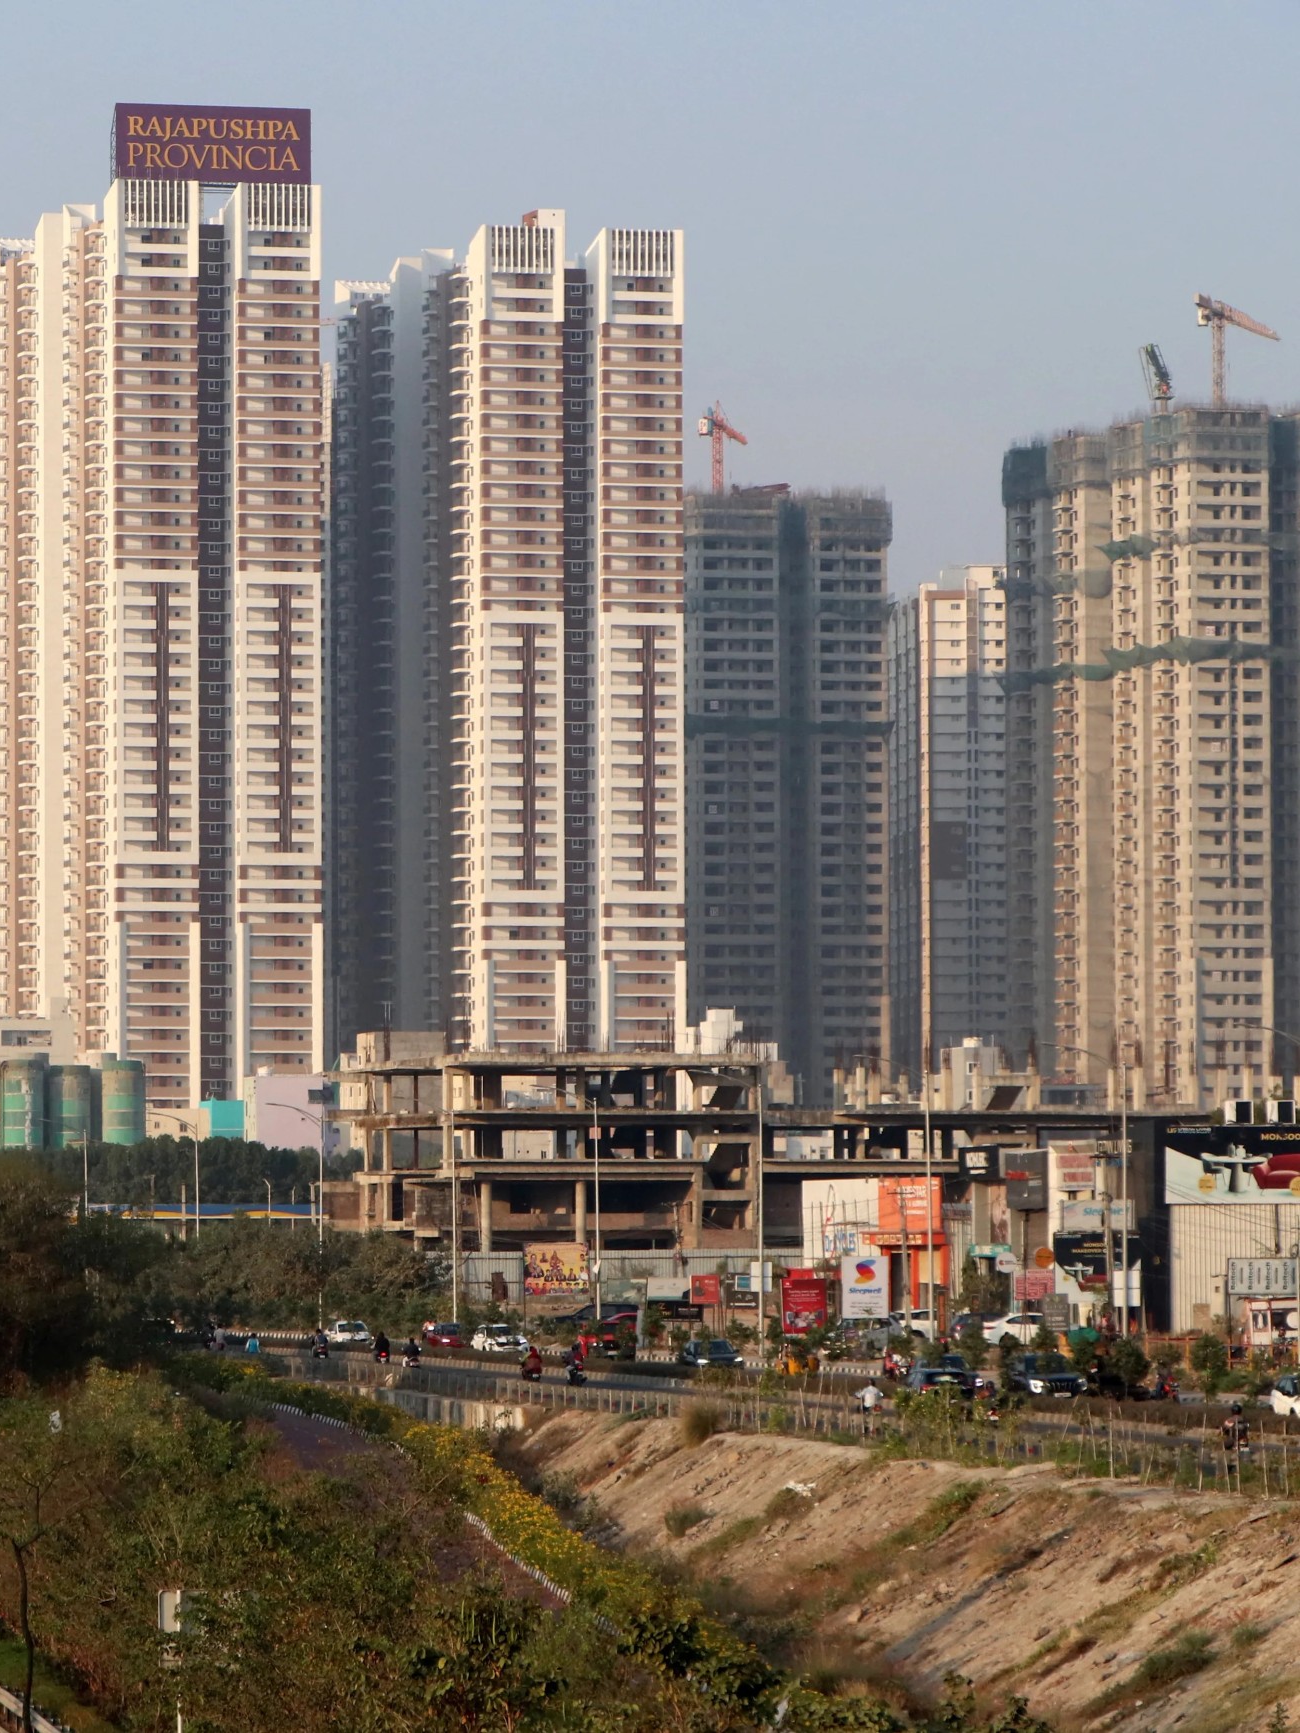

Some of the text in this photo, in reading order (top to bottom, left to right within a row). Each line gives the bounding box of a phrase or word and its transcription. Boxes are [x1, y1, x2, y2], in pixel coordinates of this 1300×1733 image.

[126, 115, 300, 142] RAJAPUSHPA
[126, 142, 301, 171] PROVINCIA
[848, 1287, 882, 1295] Sleepwell
